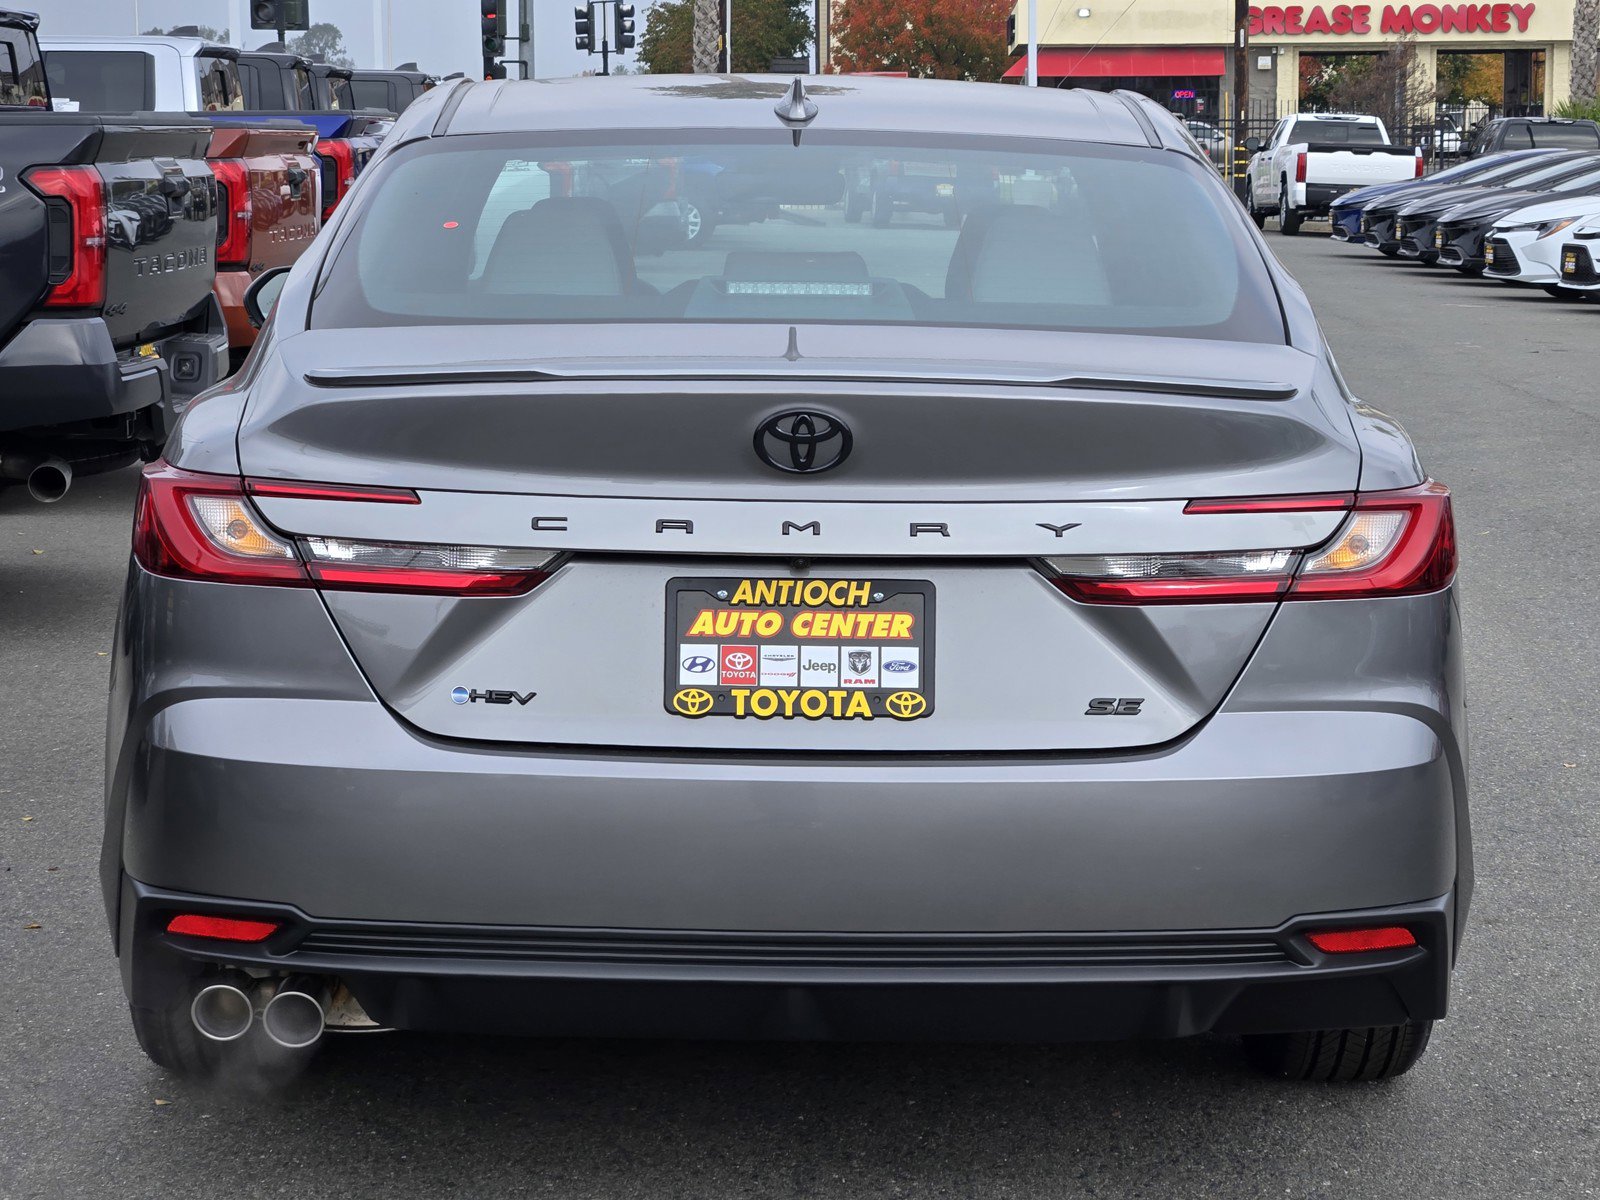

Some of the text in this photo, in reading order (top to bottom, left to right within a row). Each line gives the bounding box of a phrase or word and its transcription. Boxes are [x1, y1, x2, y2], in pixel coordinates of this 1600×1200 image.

[1248, 3, 1536, 35] GREASE MONKEY
[1331, 163, 1393, 174] TUNDRA
[269, 222, 316, 243] TACOMA
[133, 247, 207, 277] TACOMA
[530, 516, 1082, 538] CAMRY
[731, 579, 872, 607] ANTIOCH
[686, 609, 914, 639] AUTO CENTER
[721, 671, 756, 679] TOYOTA
[802, 659, 836, 674] Jeep
[888, 661, 911, 672] Ford
[470, 688, 537, 706] HEV
[731, 689, 873, 718] TOYOTA
[1084, 697, 1146, 715] SE
